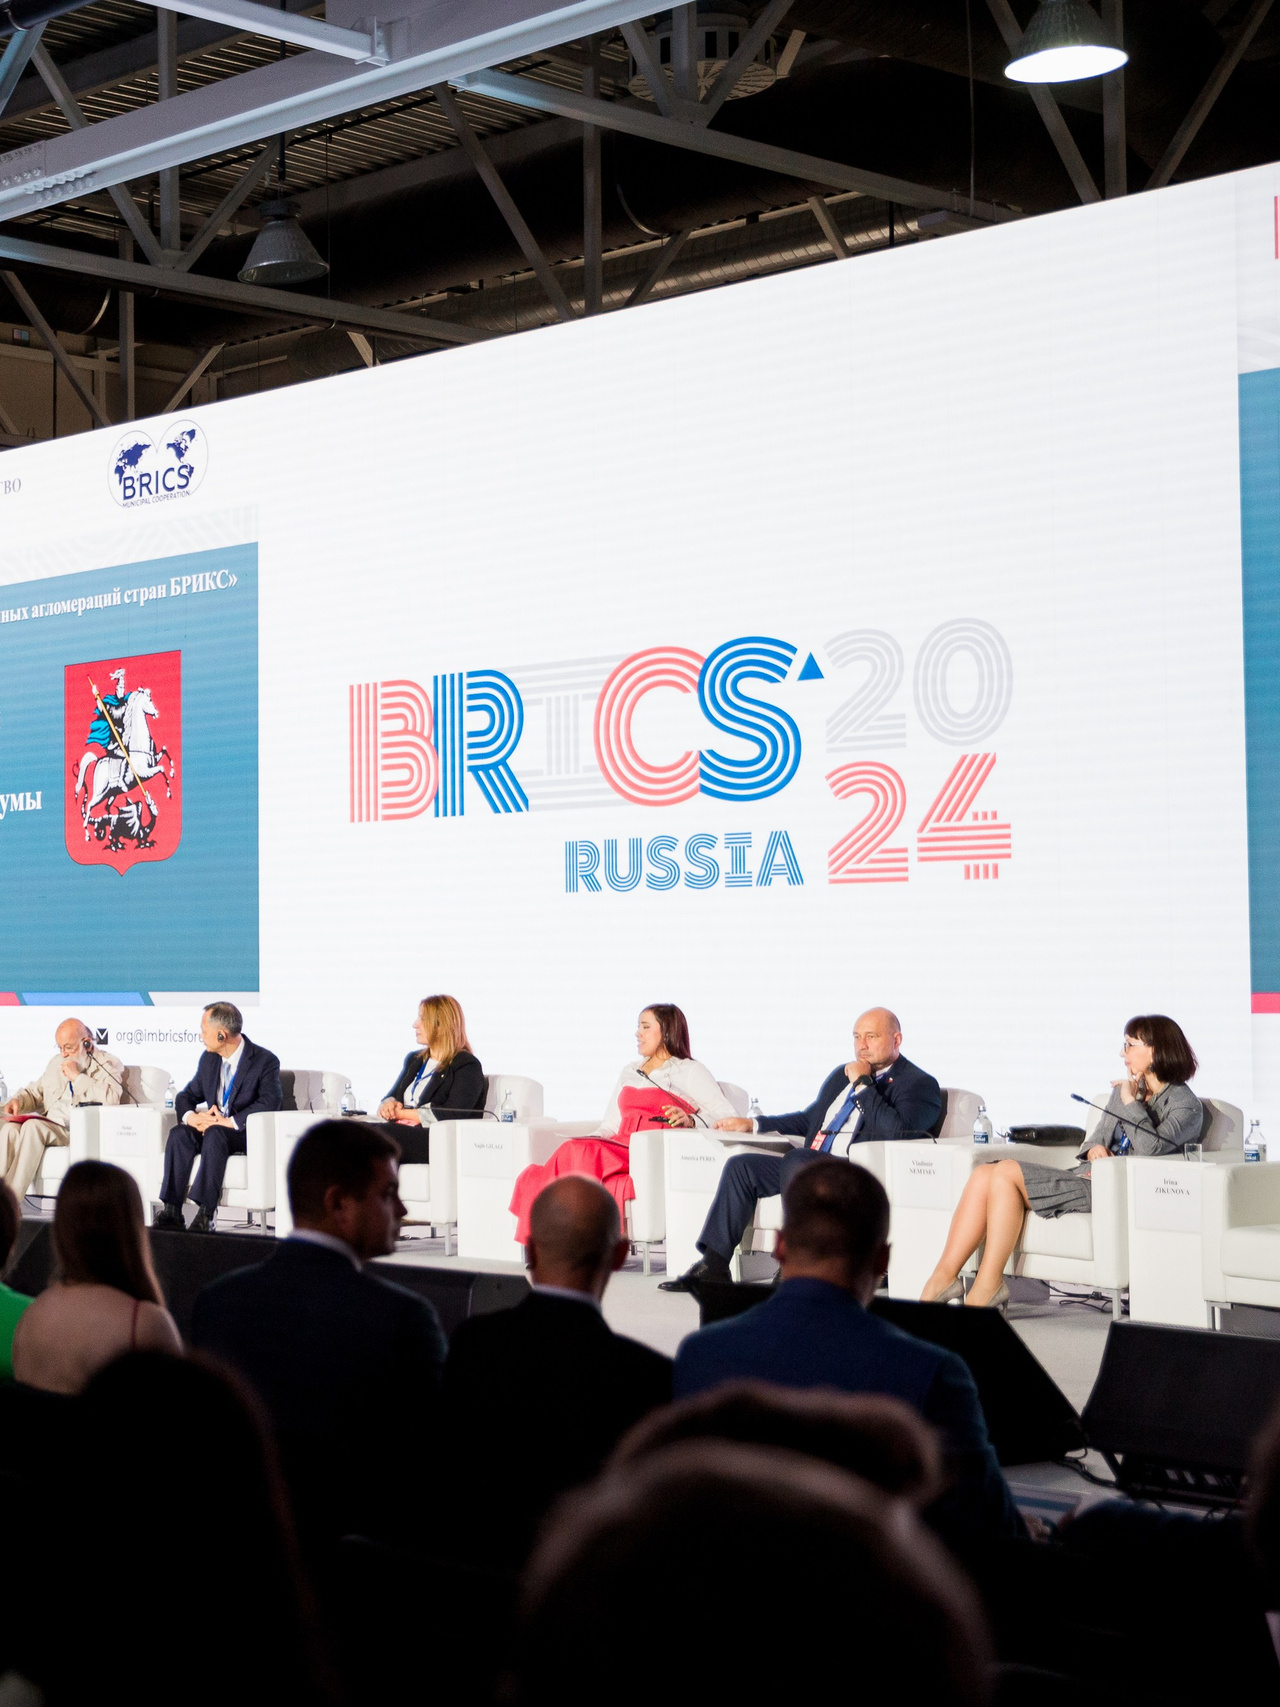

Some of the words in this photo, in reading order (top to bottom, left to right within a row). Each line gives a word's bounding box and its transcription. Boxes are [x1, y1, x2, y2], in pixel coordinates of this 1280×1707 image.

[122, 497, 151, 509] MUNICIPAL
[152, 490, 191, 504] COOPERATION
[123, 464, 190, 501] BRICS
[31, 587, 122, 618] агломераций
[123, 584, 167, 607] стран
[169, 569, 238, 598] БРИКС»
[348, 635, 803, 824] BRICS
[824, 617, 1013, 753] 20
[564, 830, 804, 894] RUSSIA
[824, 752, 1012, 884] 24
[1154, 1186, 1191, 1196] ZIKUNOVA
[1163, 1178, 1178, 1186] Irina
